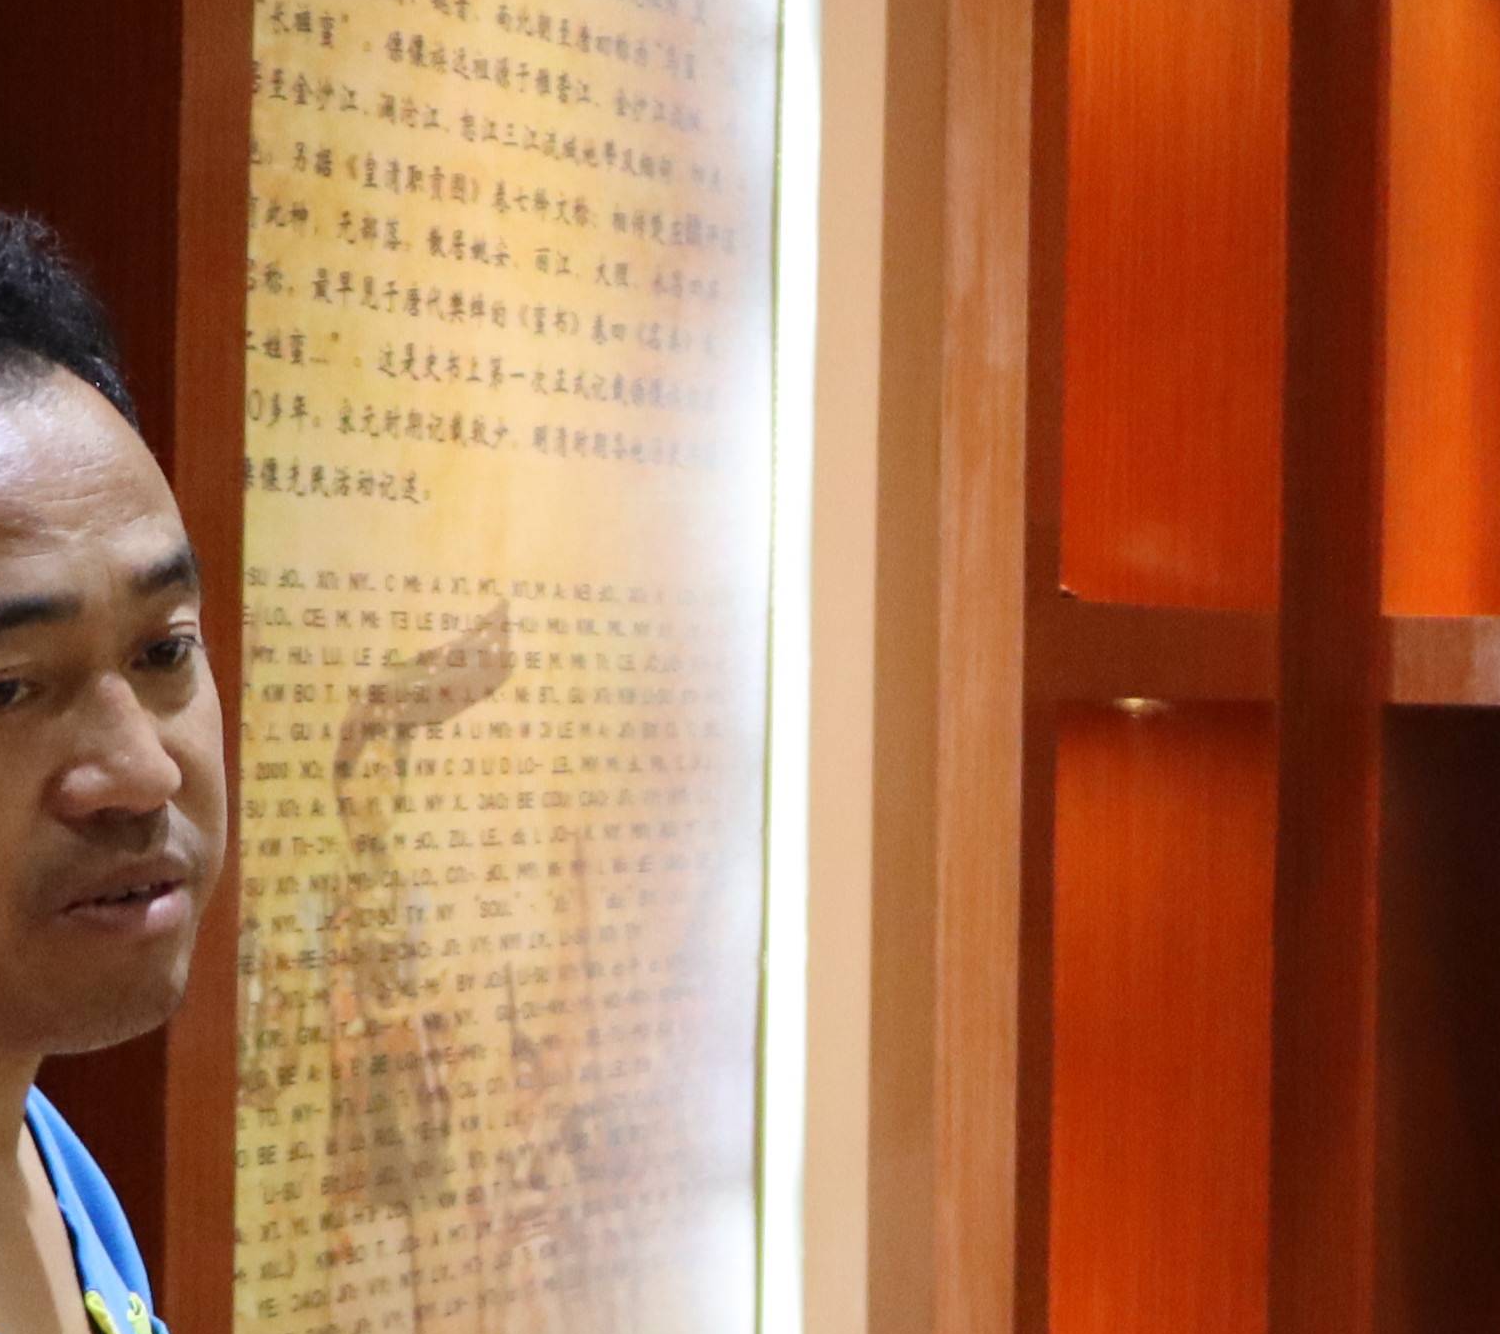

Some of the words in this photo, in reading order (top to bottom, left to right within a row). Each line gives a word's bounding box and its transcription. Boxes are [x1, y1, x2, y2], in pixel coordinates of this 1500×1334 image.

[244, 454, 431, 507] 僳先民活动记述。
